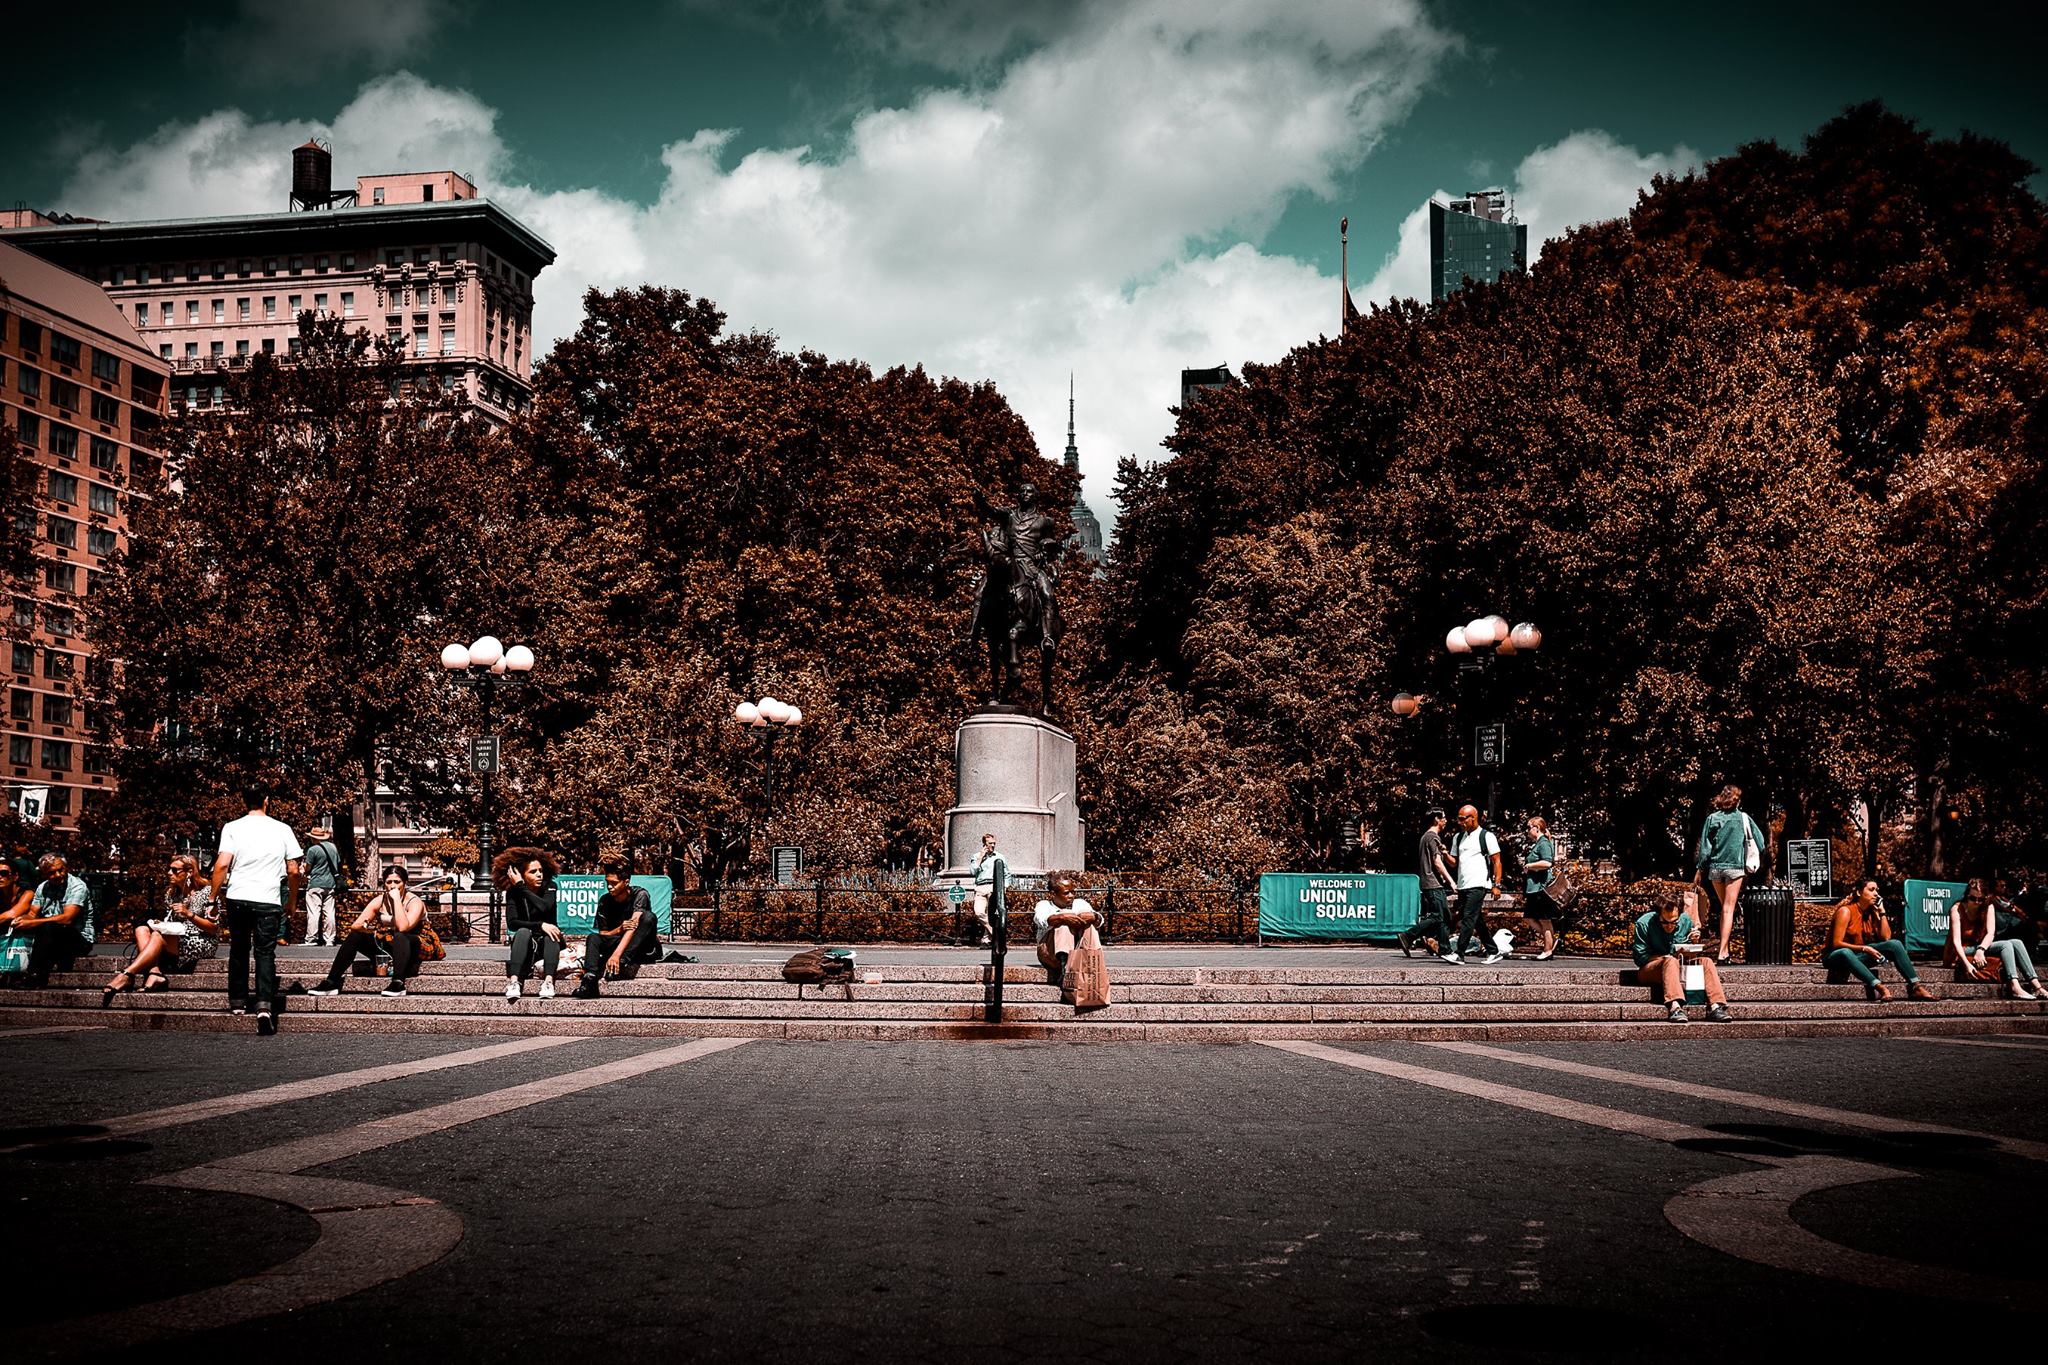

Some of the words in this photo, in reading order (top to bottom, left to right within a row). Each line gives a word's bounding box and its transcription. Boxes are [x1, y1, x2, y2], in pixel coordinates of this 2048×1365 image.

[560, 881, 605, 889] WELCOME
[1310, 879, 1352, 888] WELCOME
[1354, 879, 1366, 888] TO
[1300, 889, 1347, 903] UNION
[567, 903, 598, 920] SQU
[1316, 905, 1376, 921] SQUARE
[1922, 898, 1943, 914] UNION
[1930, 915, 1950, 933] SQUA
